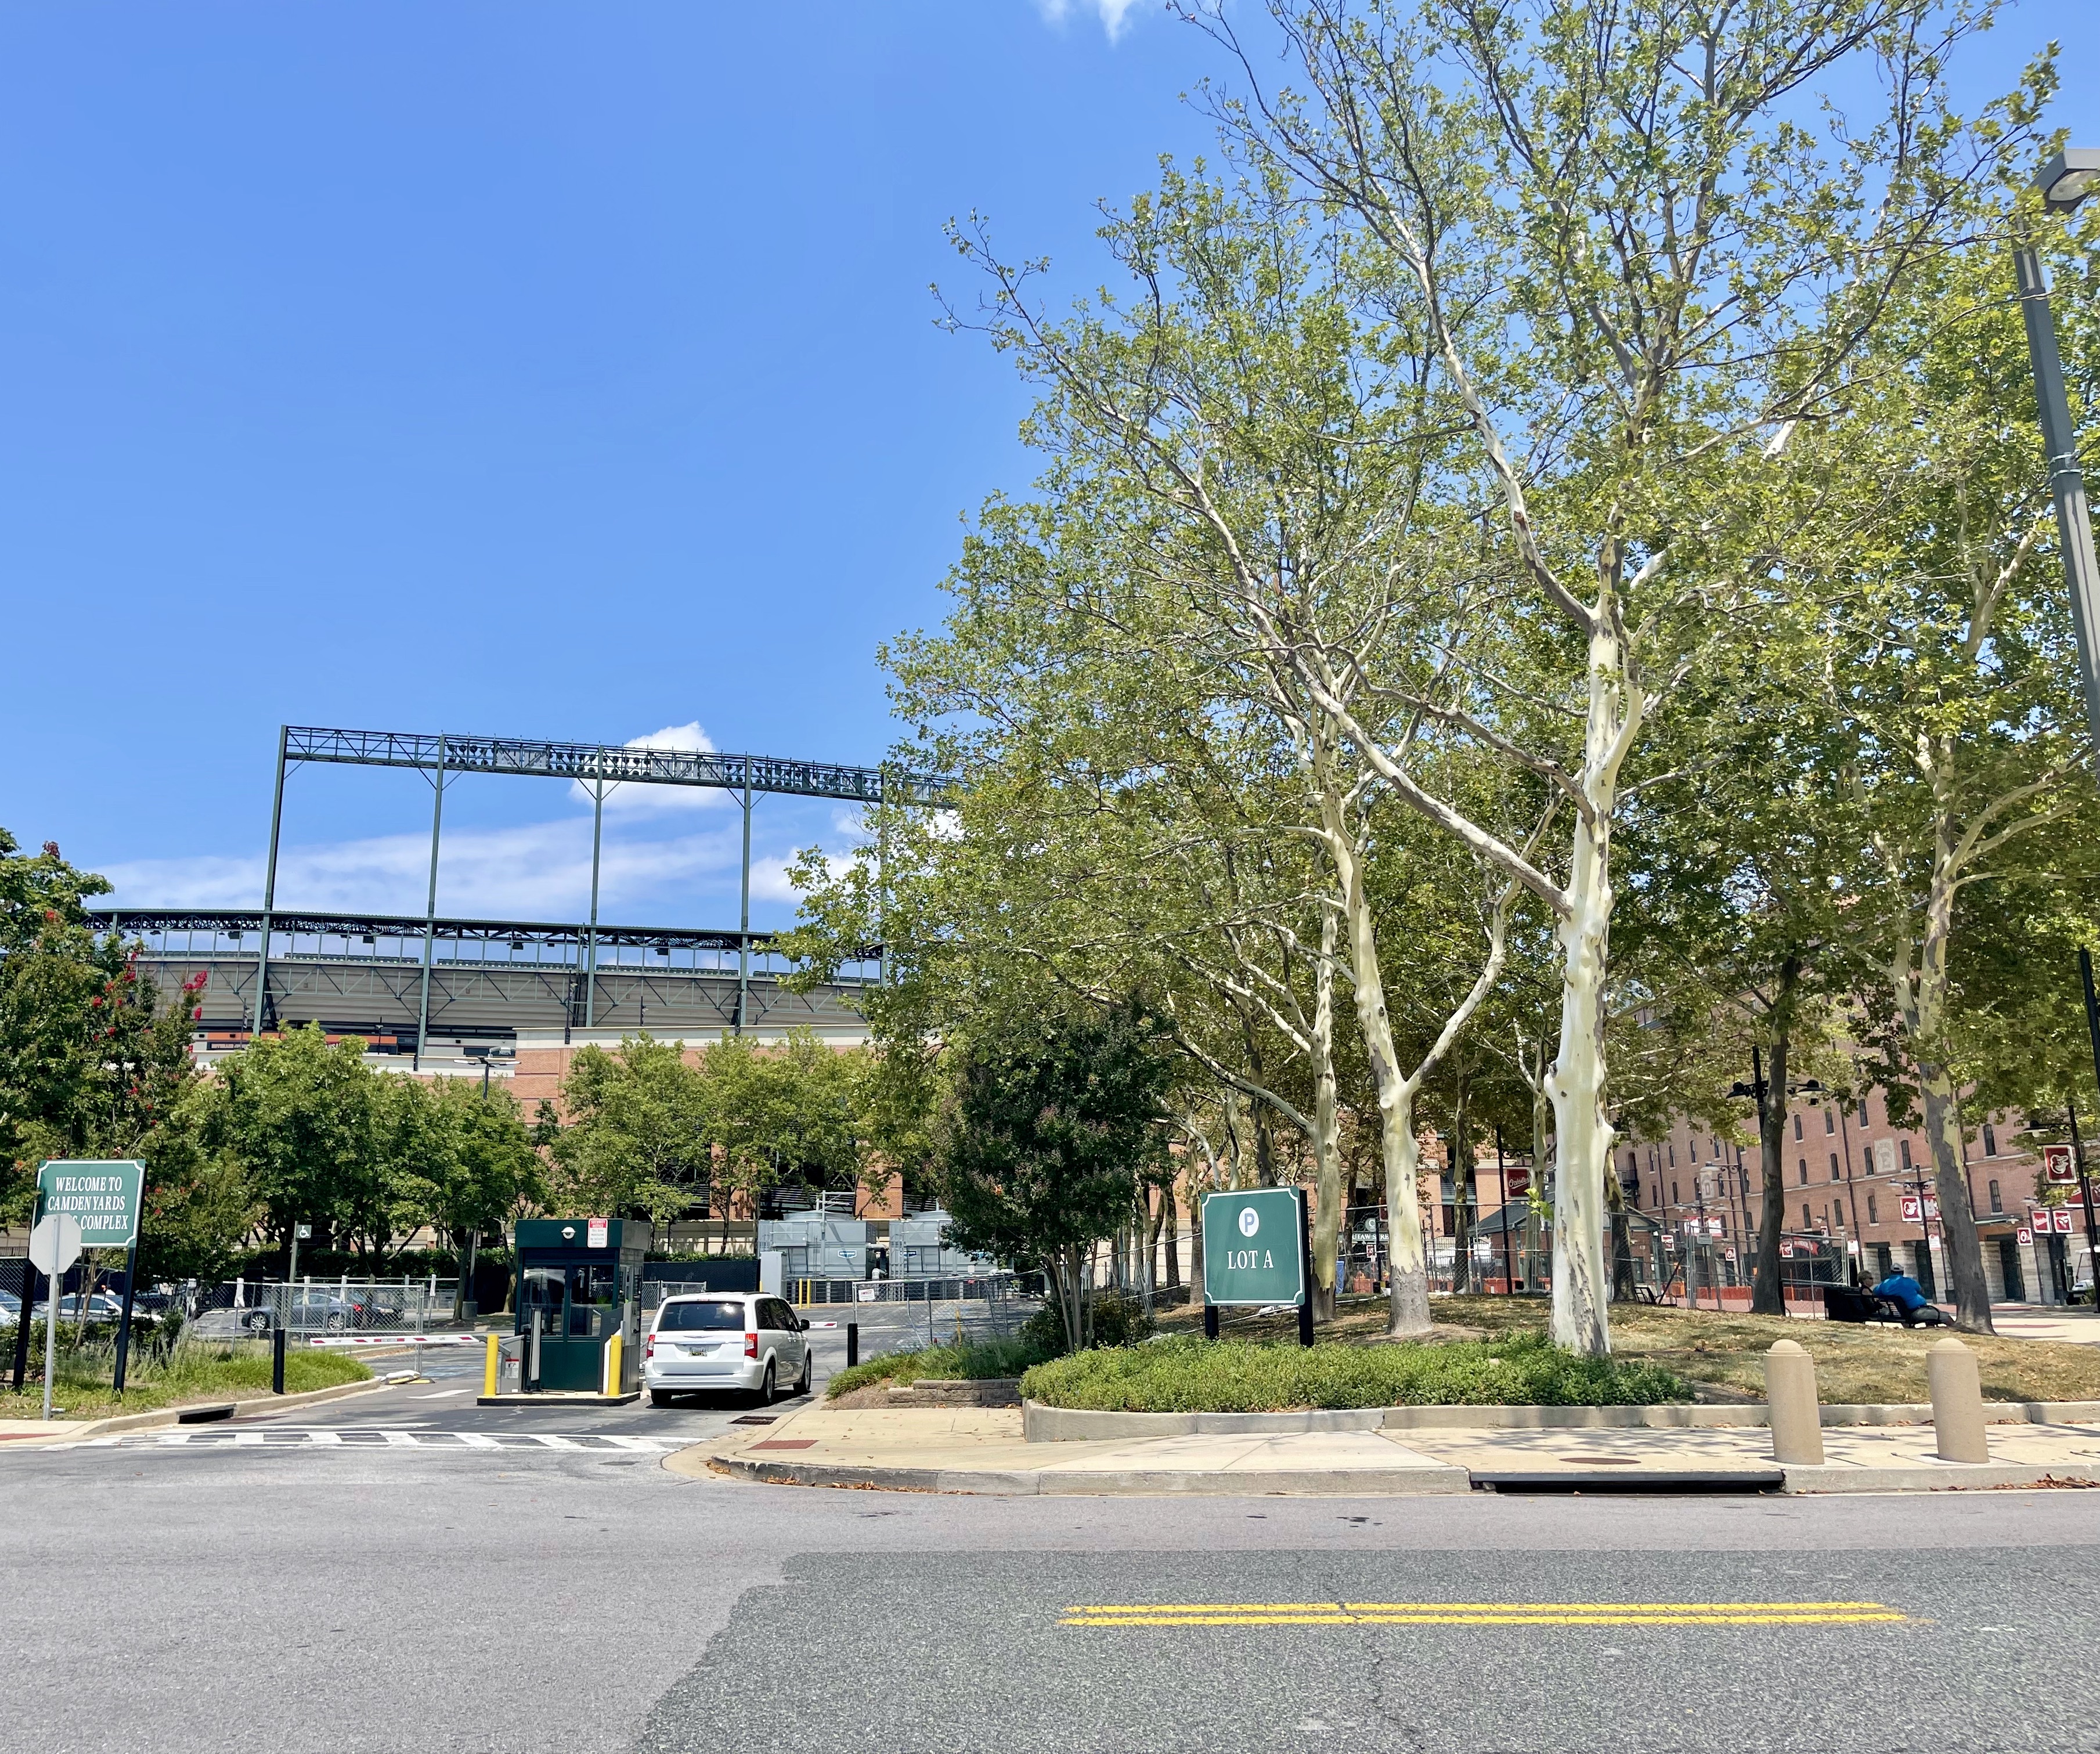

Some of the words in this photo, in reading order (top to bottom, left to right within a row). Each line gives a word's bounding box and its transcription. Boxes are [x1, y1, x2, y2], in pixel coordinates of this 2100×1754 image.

[56, 1176, 107, 1192] WELCOME
[109, 1176, 122, 1192] TO
[48, 1196, 93, 1211] CAMDEN
[93, 1196, 125, 1211] YARDS
[81, 1215, 129, 1230] COMPLEX
[1244, 1213, 1254, 1232] P
[1227, 1250, 1258, 1269] LOT
[1262, 1249, 1274, 1268] A
